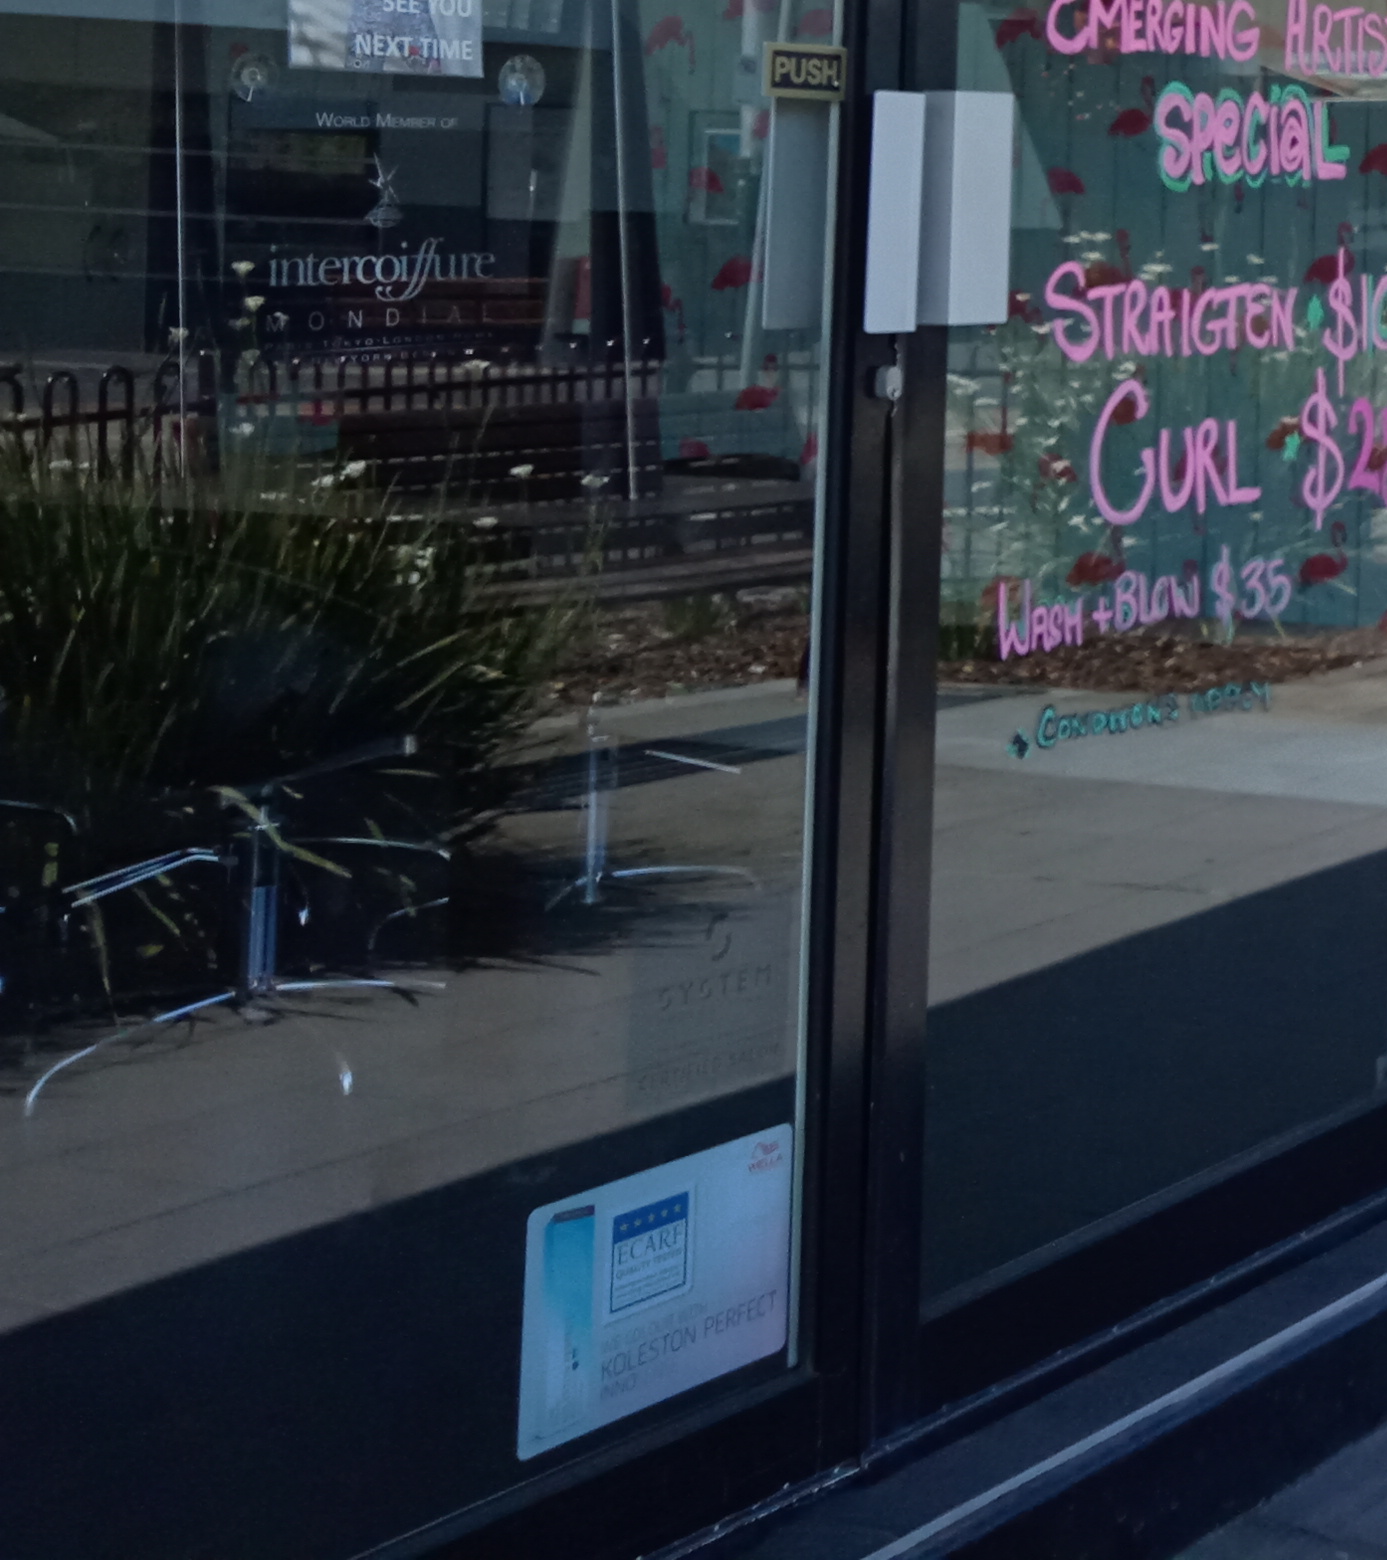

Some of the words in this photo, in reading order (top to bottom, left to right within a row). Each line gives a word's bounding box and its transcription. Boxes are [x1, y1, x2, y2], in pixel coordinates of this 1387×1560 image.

[355, 32, 413, 60] NEXT
[418, 35, 474, 62] TIME
[774, 55, 841, 88] PUSH
[268, 237, 496, 302] intercoiffure
[1090, 379, 1262, 526] CURL
[1210, 546, 1293, 644] $35
[657, 963, 772, 1012] SYSTEM
[616, 1220, 685, 1266] ECARF
[601, 1324, 697, 1382] KOLESTON
[703, 1288, 778, 1339] PERFECT
